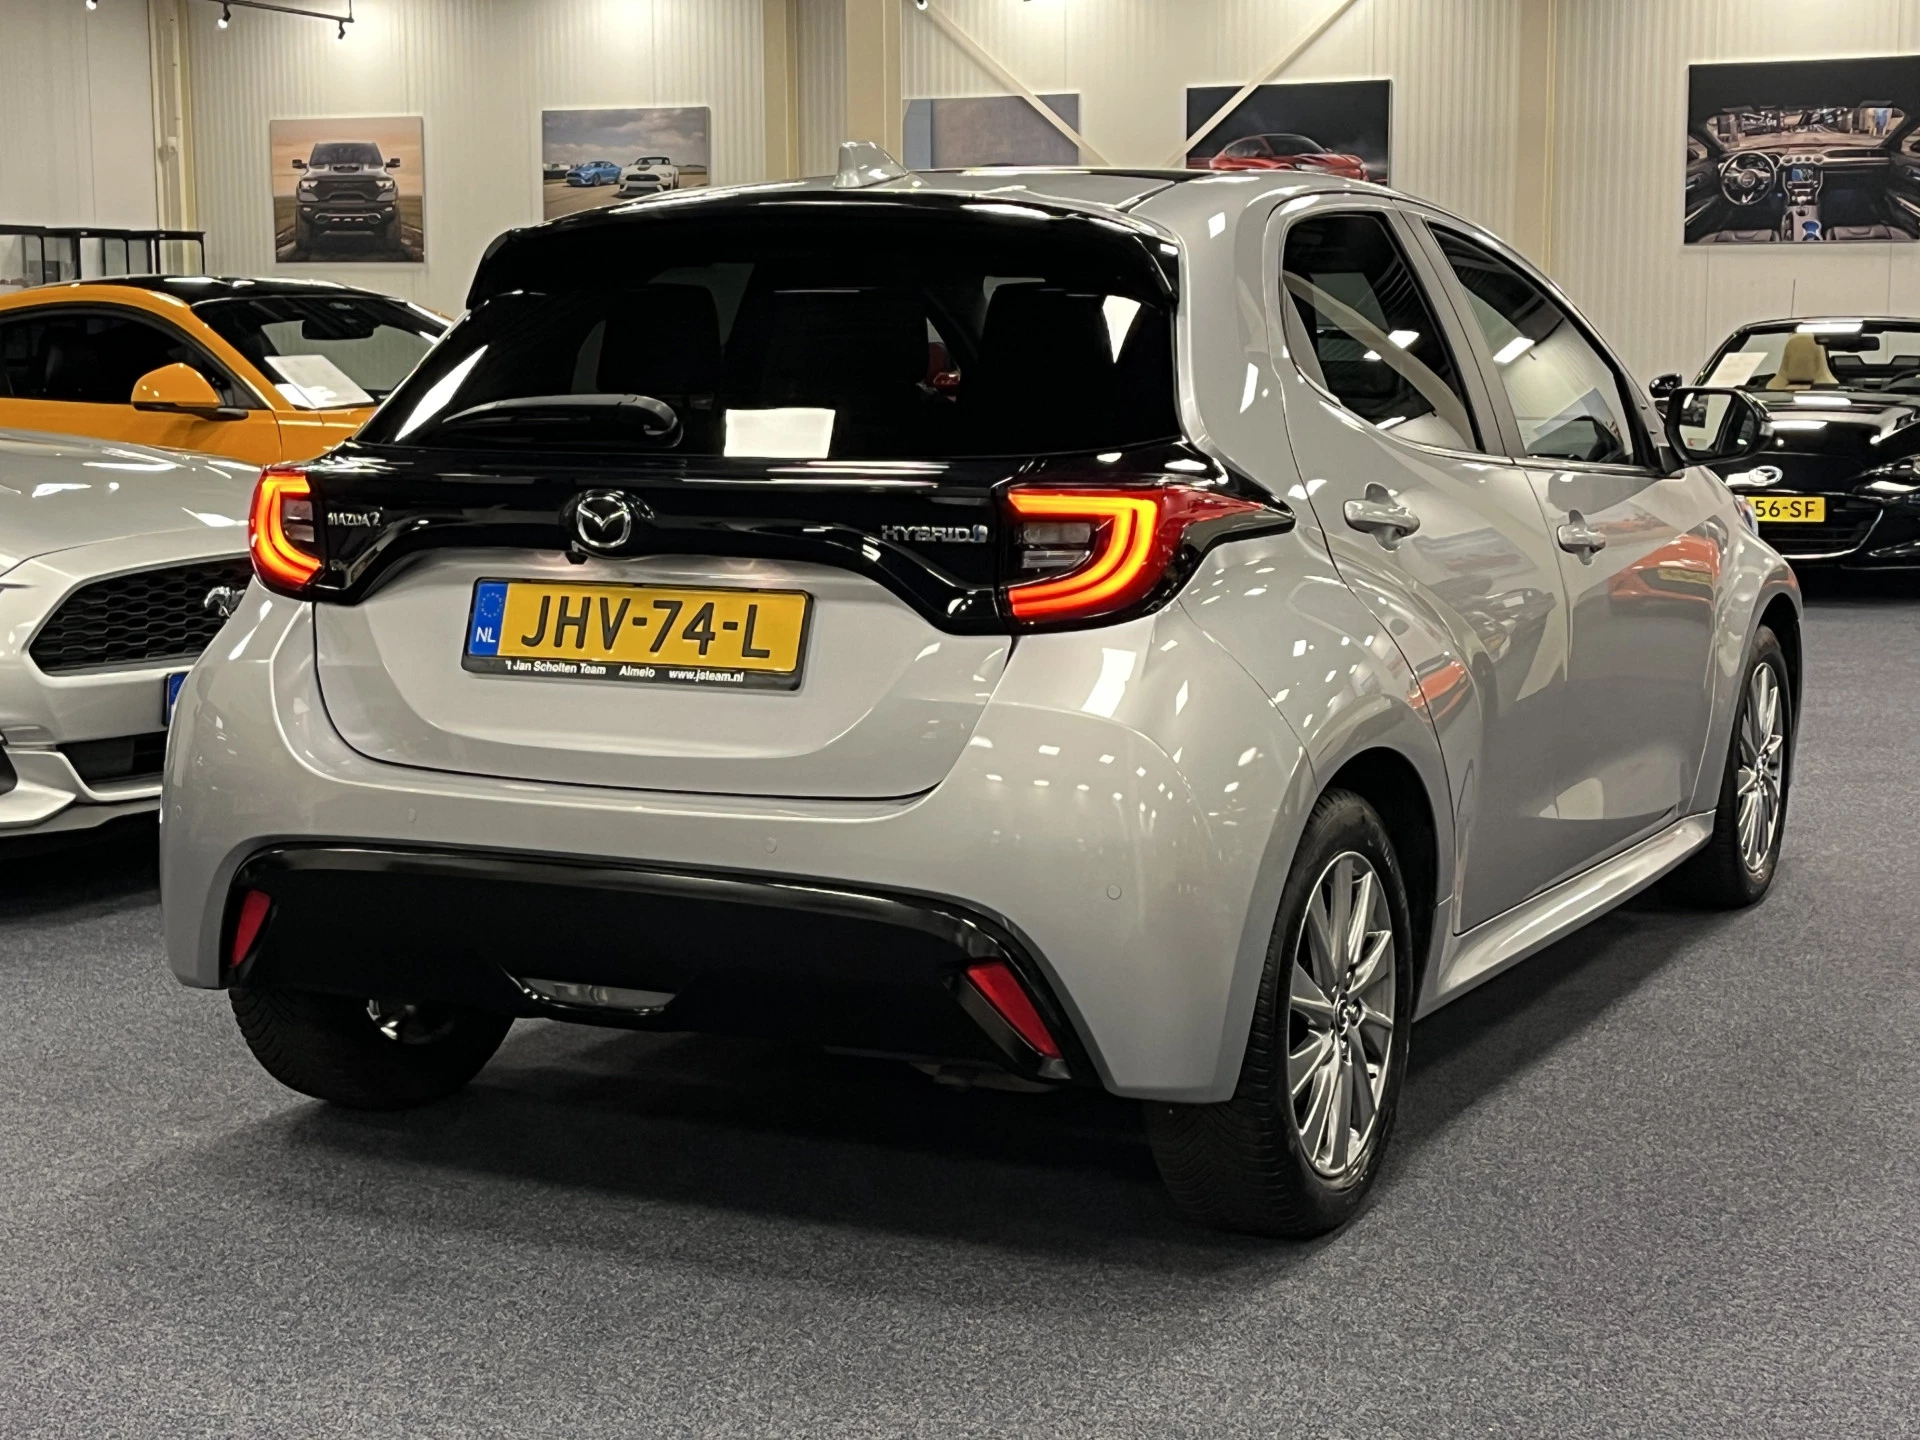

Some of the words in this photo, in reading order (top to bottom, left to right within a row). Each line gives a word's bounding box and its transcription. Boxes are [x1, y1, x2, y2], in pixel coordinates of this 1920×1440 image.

[881, 525, 971, 542] HYBRID
[475, 626, 497, 643] NL
[521, 595, 771, 659] JHV-74-L
[513, 660, 532, 671] Jan
[533, 661, 577, 673] Scholten
[579, 663, 607, 675] Team
[619, 665, 656, 678] Almelo
[669, 669, 745, 683] www.jsteam.nl
